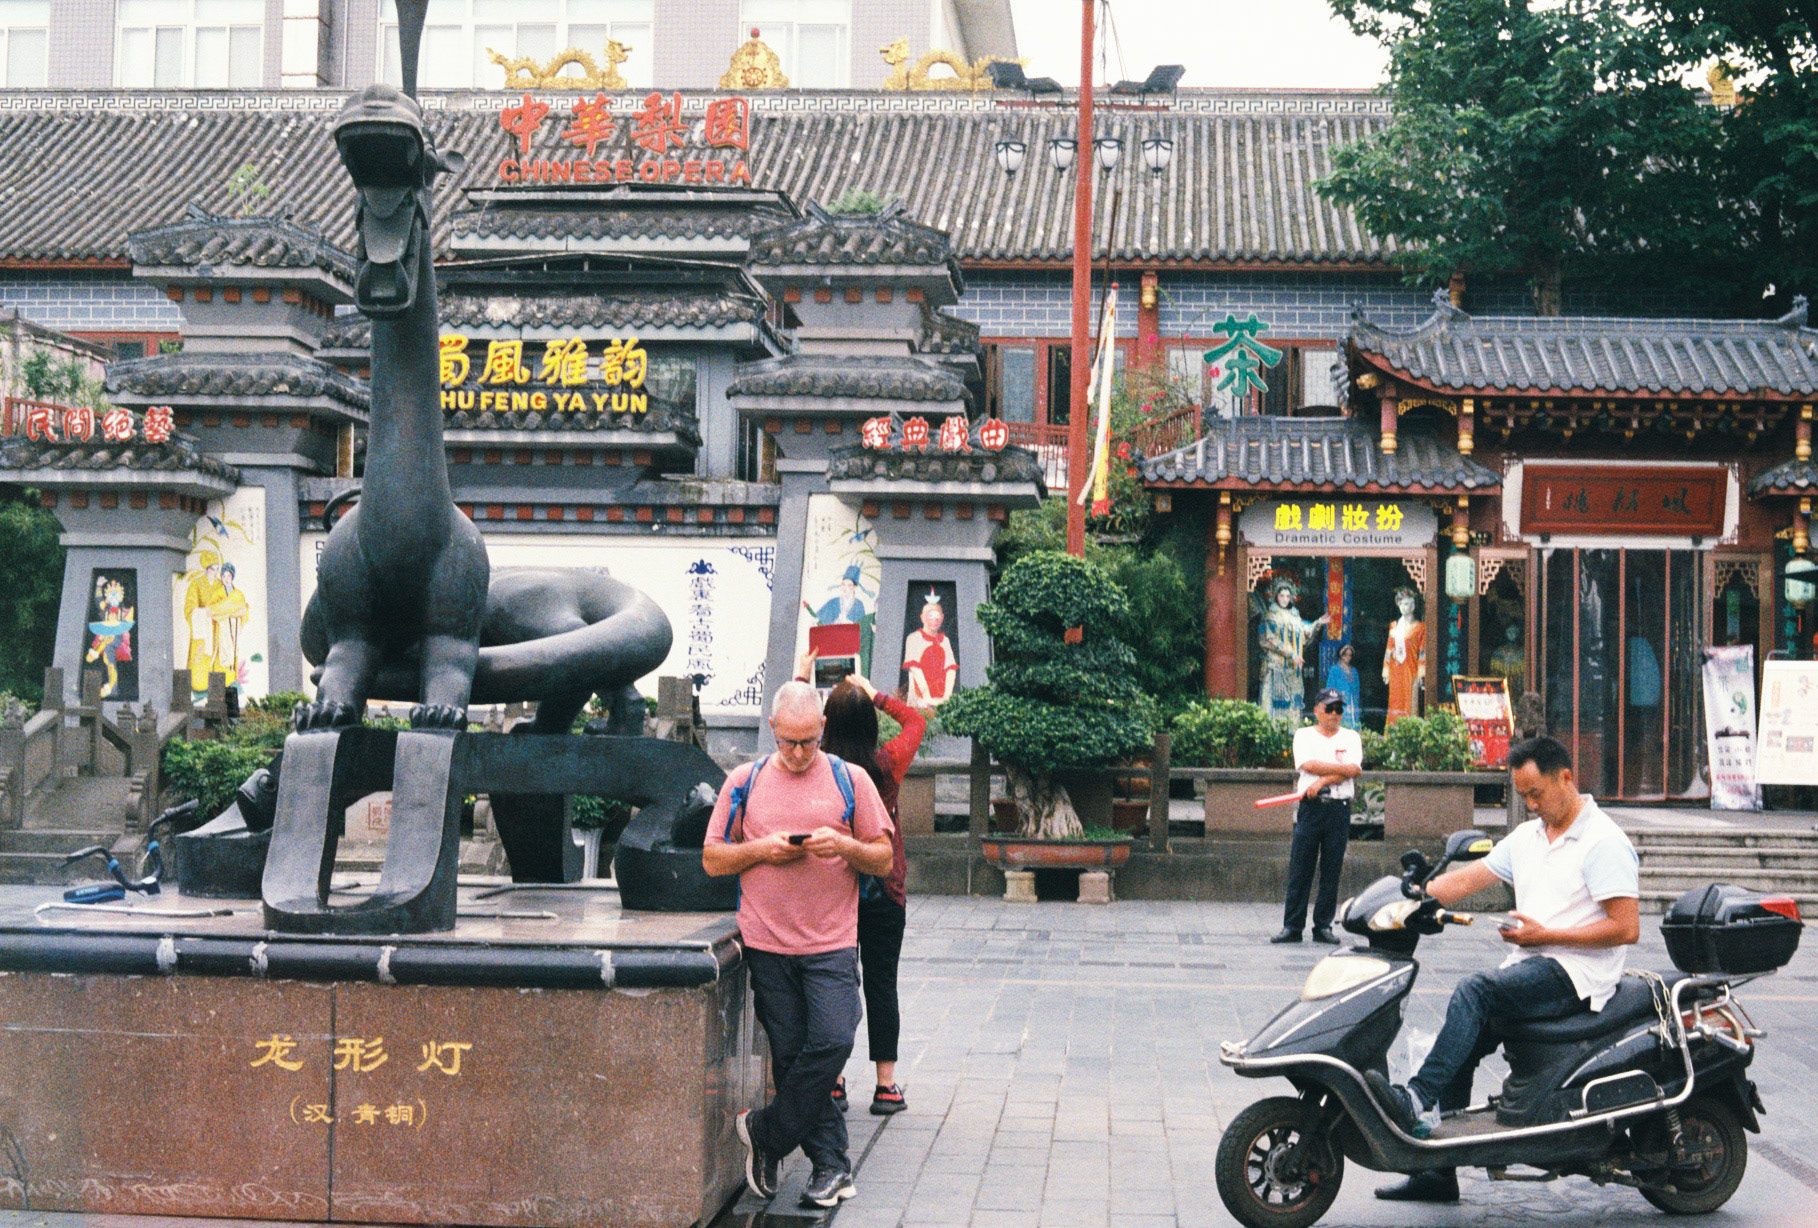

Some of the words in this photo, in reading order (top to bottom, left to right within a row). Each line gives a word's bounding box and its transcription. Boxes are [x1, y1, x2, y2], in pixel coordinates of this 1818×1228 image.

[500, 92, 750, 157] 中華梨園
[500, 160, 633, 182] CHINESE
[639, 160, 751, 183] OPERA
[1204, 313, 1283, 396] 茶
[440, 390, 475, 410] HU
[480, 391, 548, 411] FENG
[553, 392, 587, 411] YA
[592, 392, 648, 413] YUN
[1275, 533, 1336, 544] Dramatic
[1343, 533, 1402, 544] Costume
[250, 1033, 473, 1076] 龙形灯
